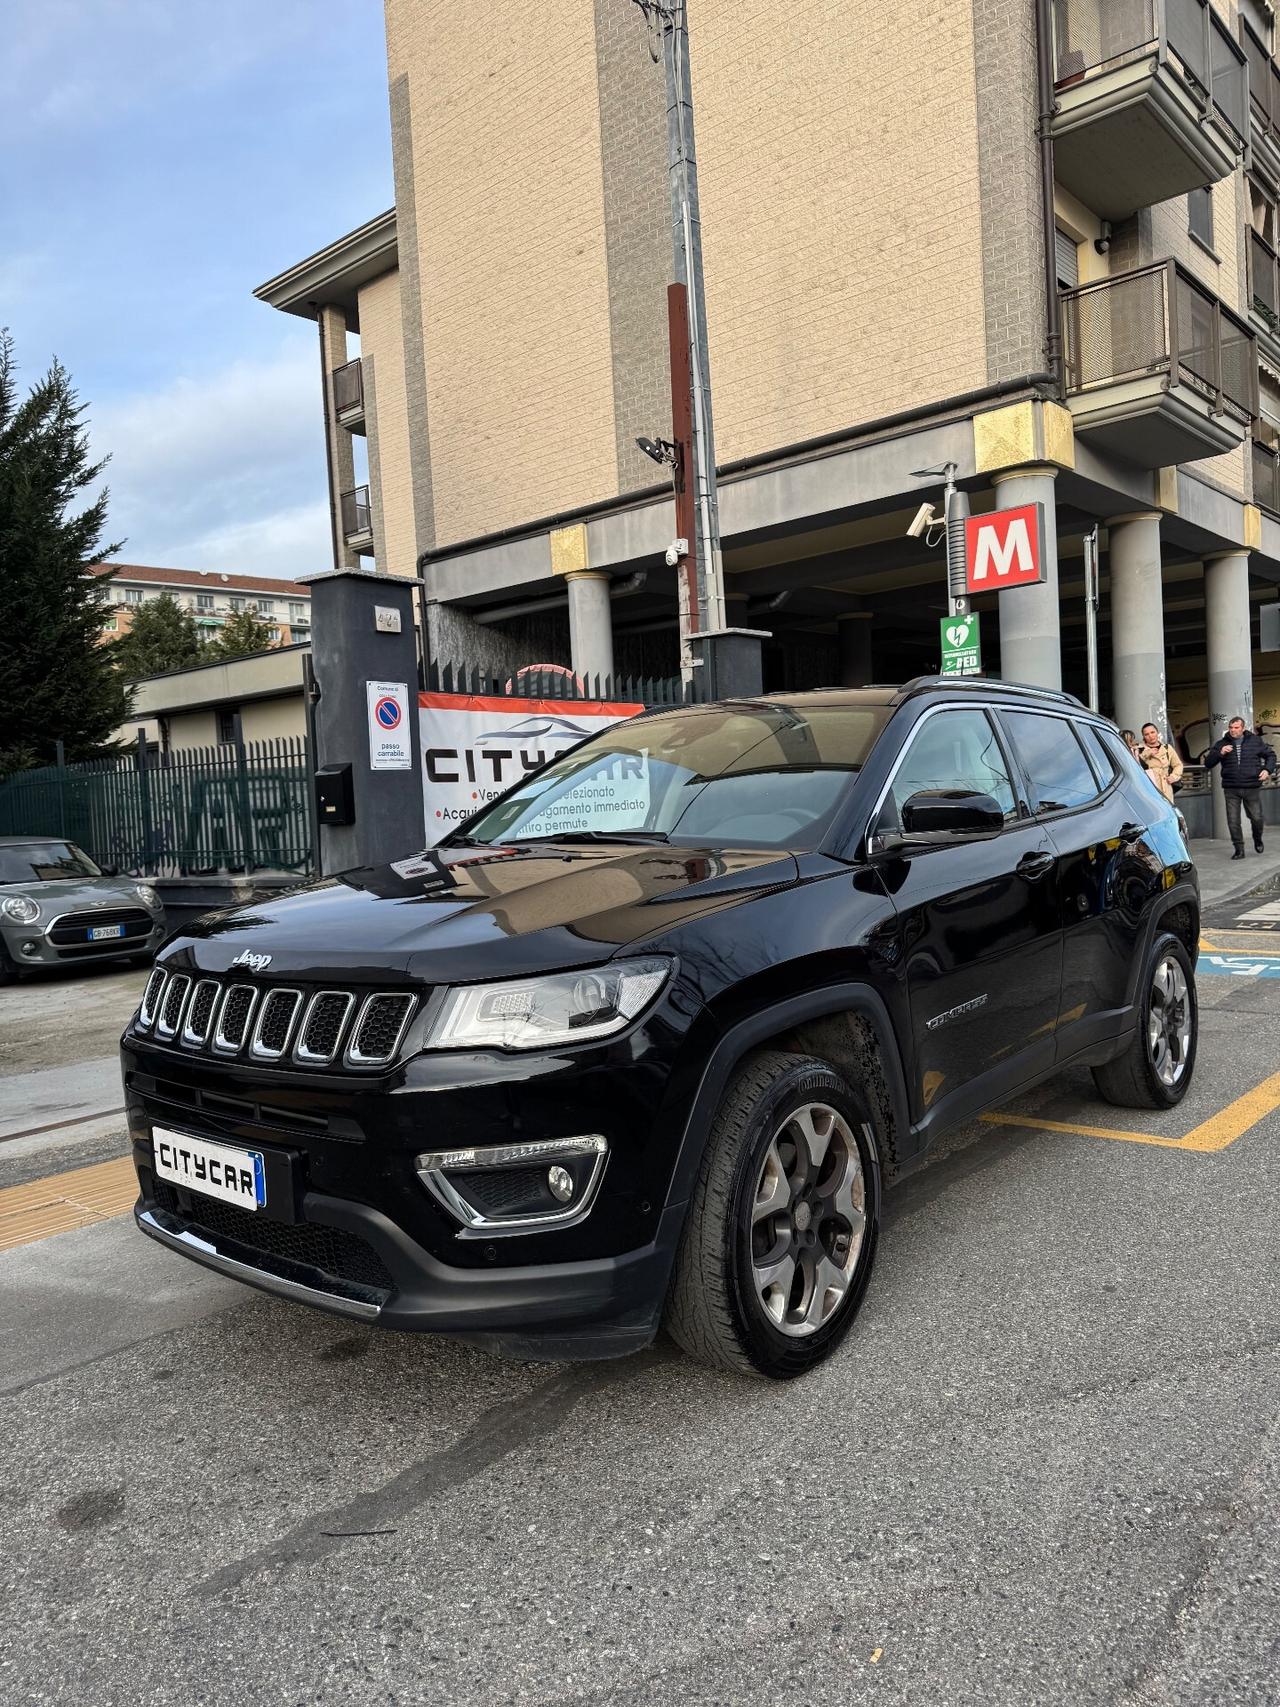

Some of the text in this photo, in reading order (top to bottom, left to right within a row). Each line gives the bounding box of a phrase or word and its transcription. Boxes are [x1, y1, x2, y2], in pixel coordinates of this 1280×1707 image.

[973, 518, 1034, 581] M
[377, 749, 405, 757] carrabile
[594, 800, 645, 813] immediato
[545, 819, 588, 834] permute
[232, 949, 273, 971] Jeep
[160, 1143, 254, 1197] CITYCAR
